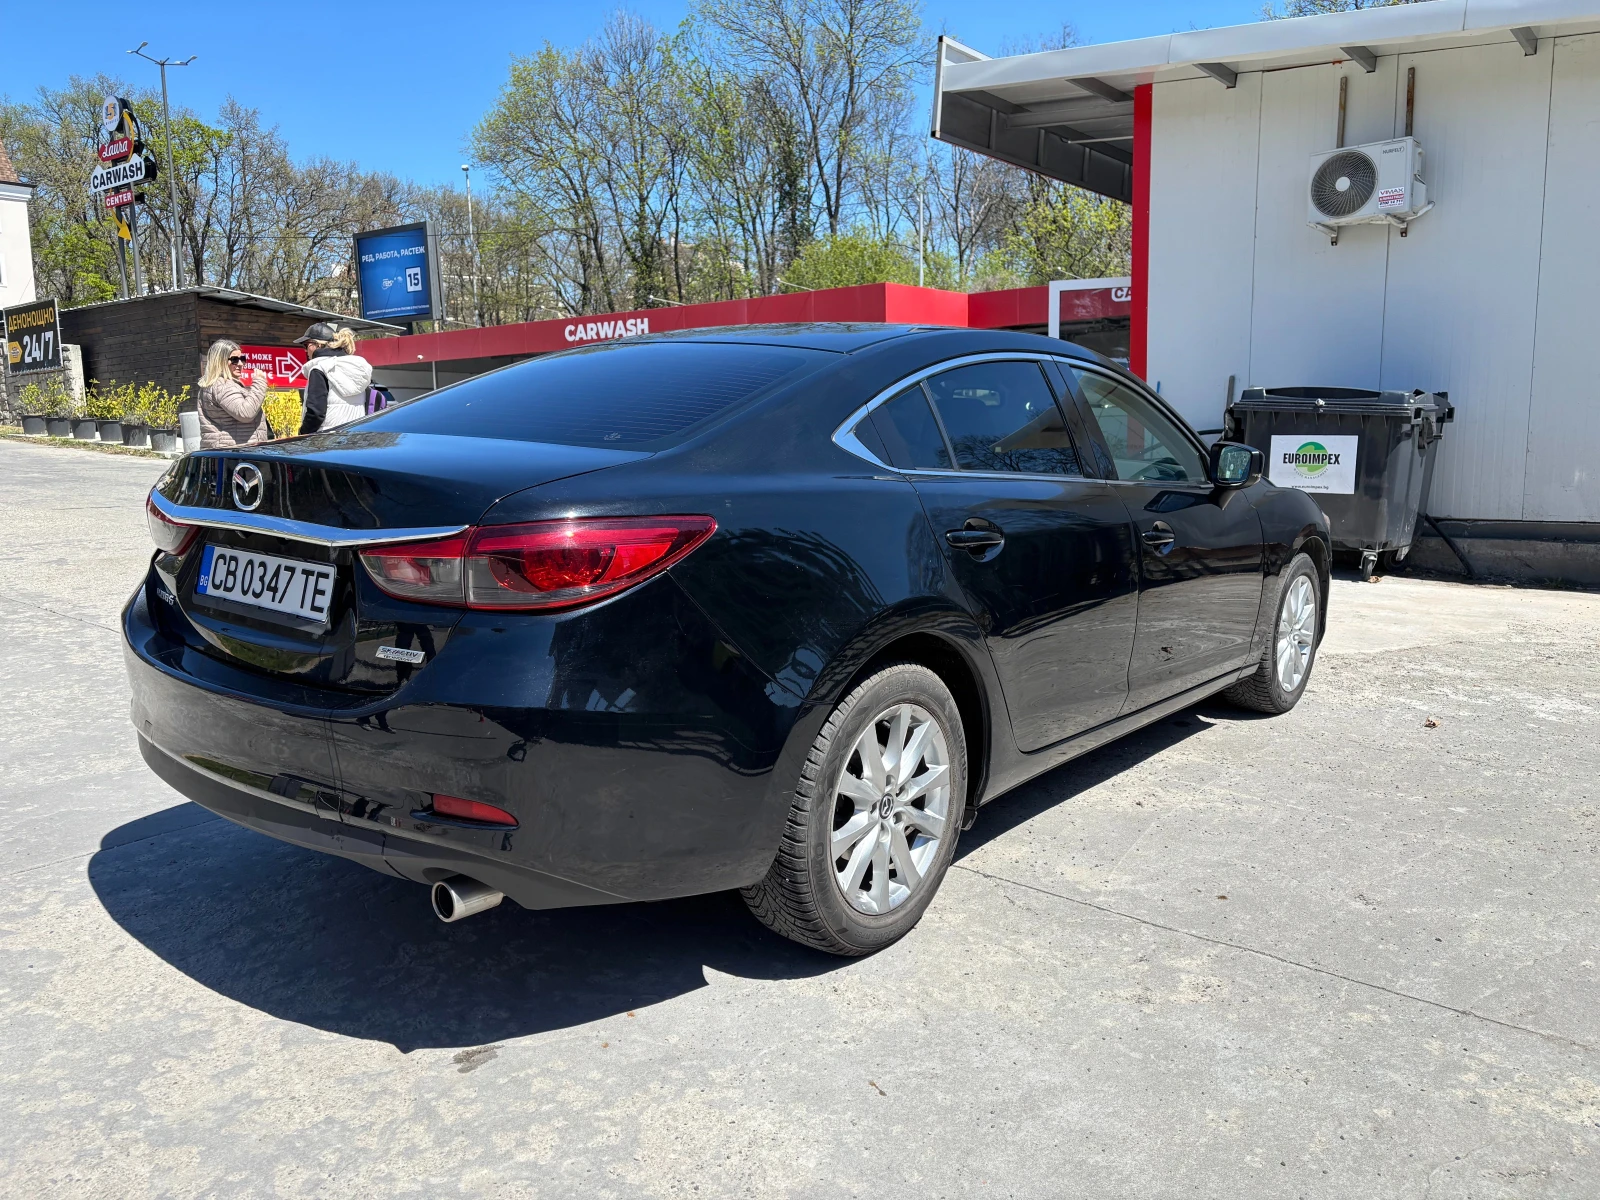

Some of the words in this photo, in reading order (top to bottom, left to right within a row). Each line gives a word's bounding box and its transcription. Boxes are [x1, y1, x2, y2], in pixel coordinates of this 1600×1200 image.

[102, 139, 128, 158] Laura
[92, 161, 143, 190] CARWASH
[106, 191, 132, 207] CENTER
[401, 245, 425, 256] РАСТЕЖ
[408, 272, 420, 287] 15
[8, 307, 55, 333] ДЕНОНОЩНО
[564, 317, 650, 342] CARWASH
[23, 331, 54, 363] 24/7
[252, 353, 273, 361] МОЖЕ
[1283, 453, 1341, 465] EUROIMPEX
[200, 574, 209, 587] BG
[211, 553, 239, 593] CB
[241, 558, 296, 604] 0347
[300, 568, 330, 614] TE
